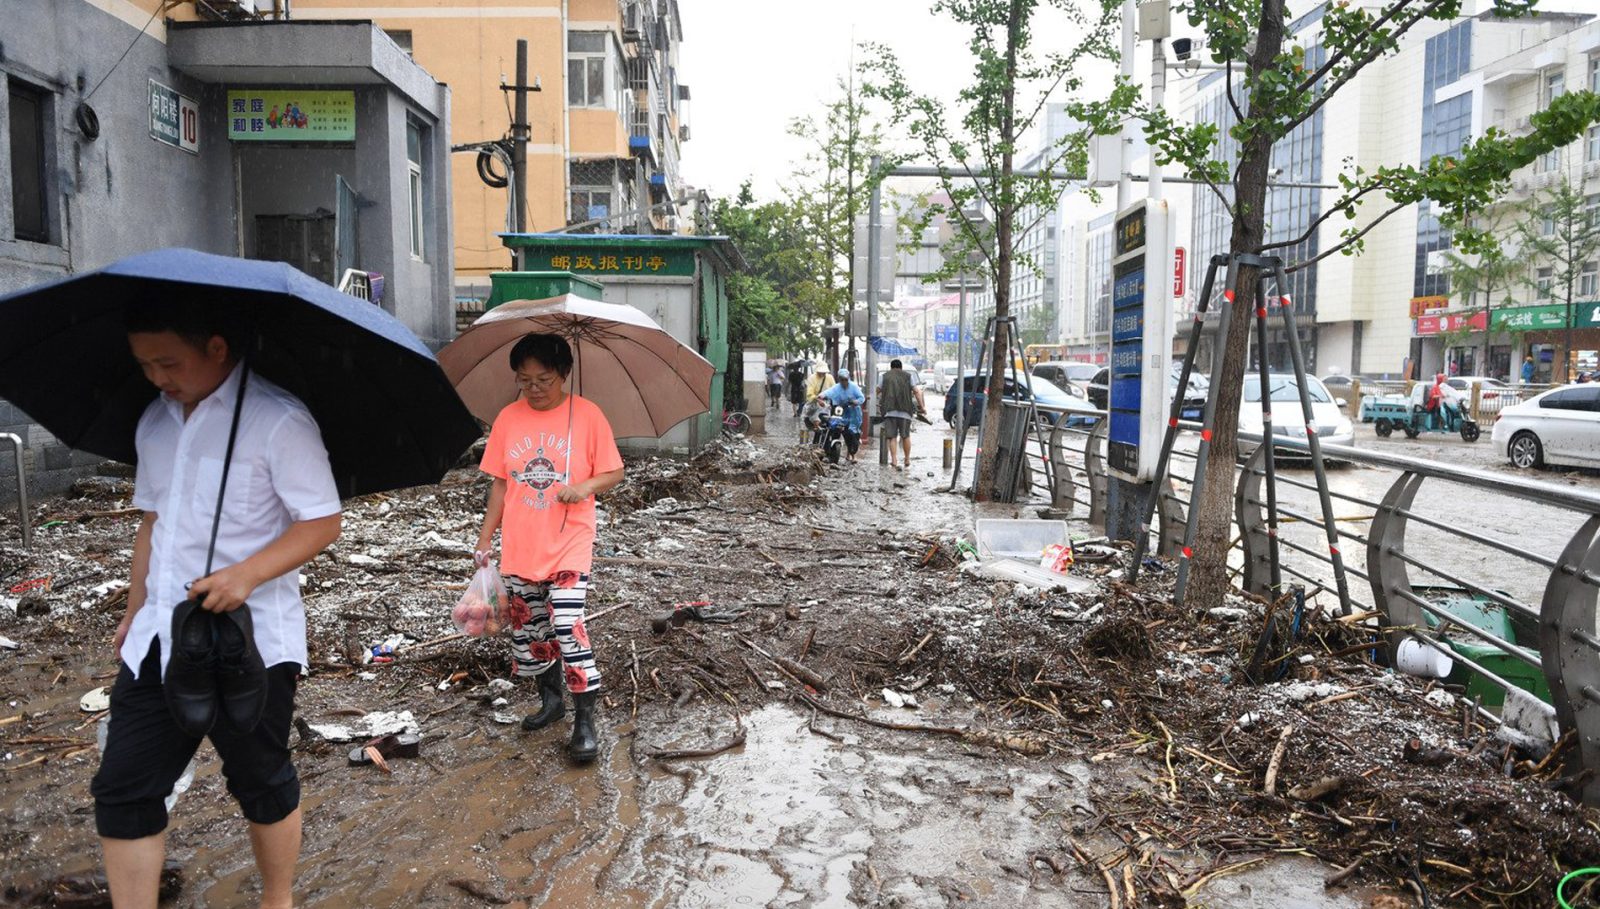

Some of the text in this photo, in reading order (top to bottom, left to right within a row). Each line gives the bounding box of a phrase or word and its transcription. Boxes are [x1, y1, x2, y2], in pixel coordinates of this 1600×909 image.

[233, 98, 263, 112] 家庭
[182, 106, 196, 144] 10
[233, 118, 264, 132] 和睦
[551, 255, 667, 271] 邮政报刊亭
[510, 436, 532, 458] OLD
